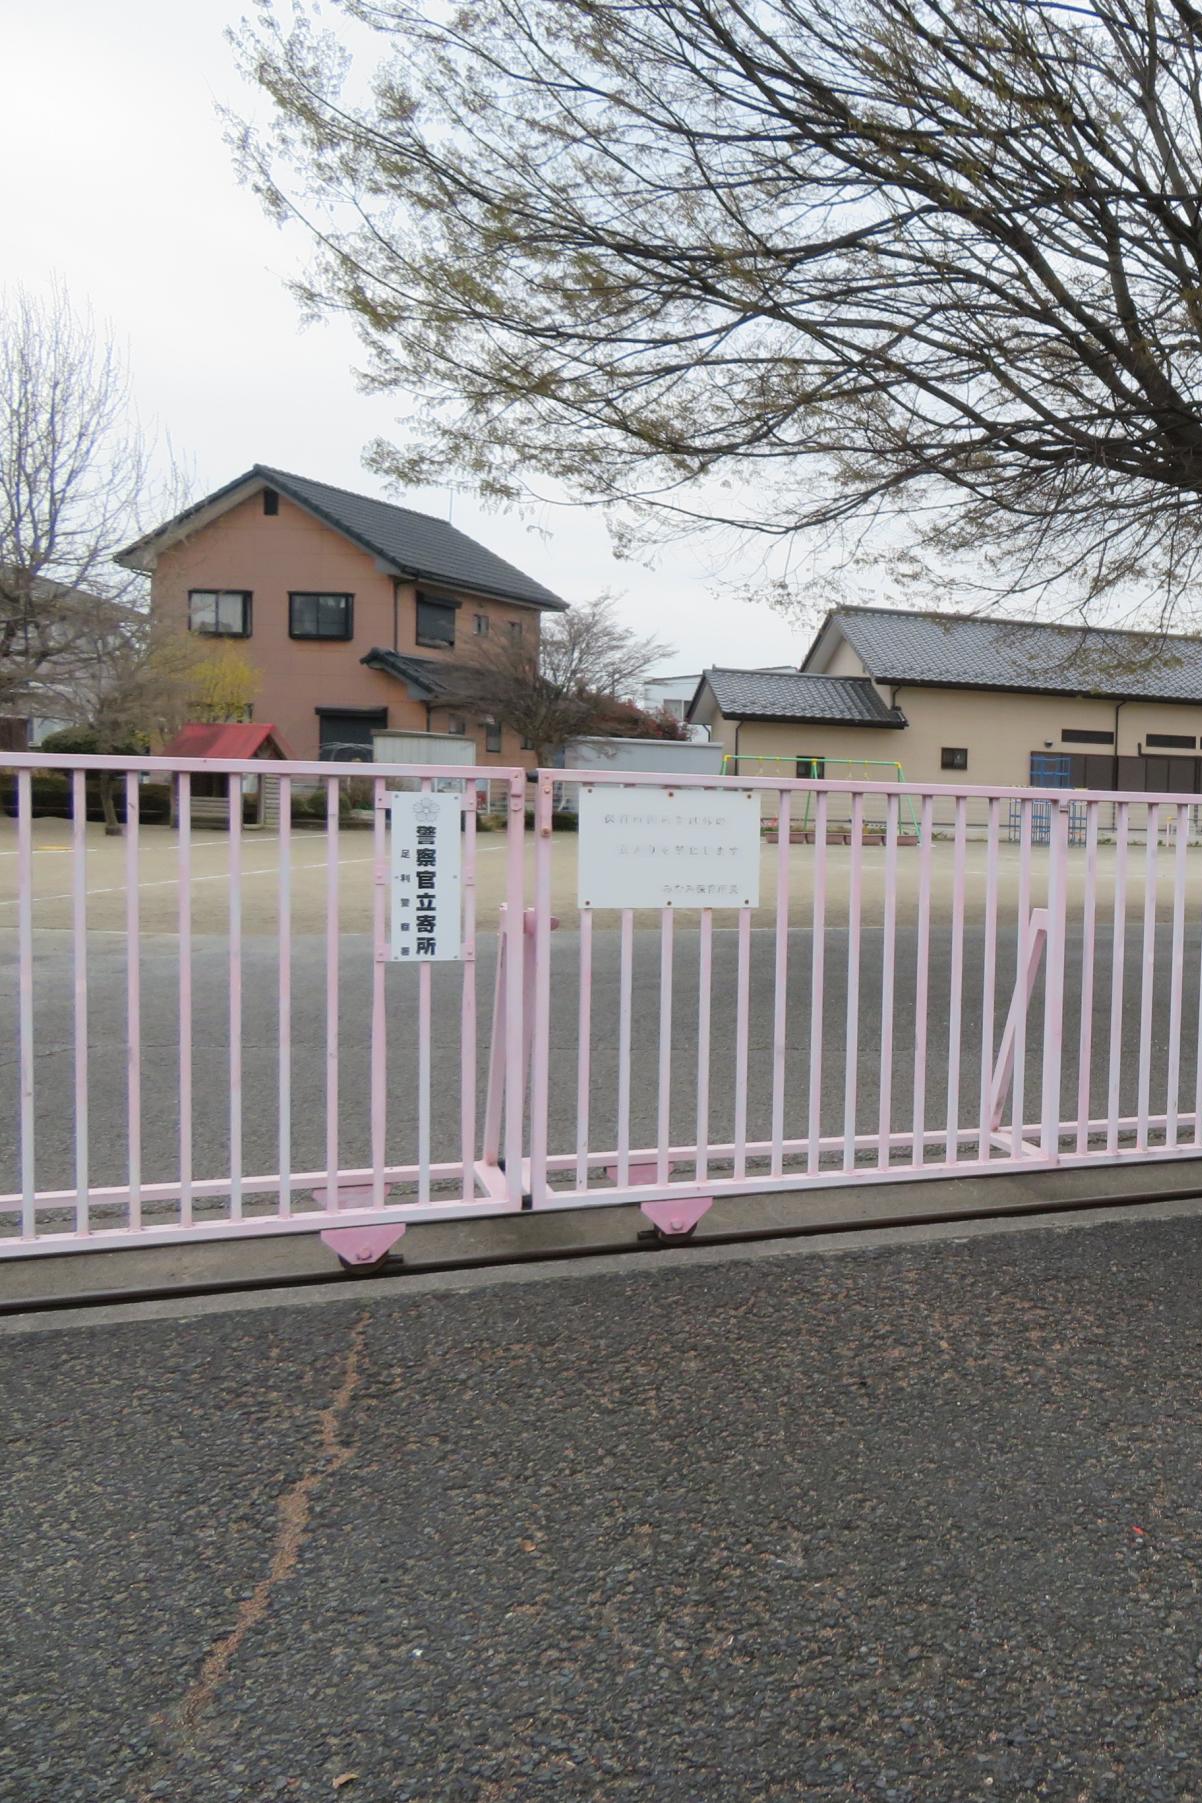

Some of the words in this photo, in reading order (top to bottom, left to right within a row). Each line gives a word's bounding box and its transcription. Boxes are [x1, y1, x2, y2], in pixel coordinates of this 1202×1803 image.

[416, 825, 437, 956] 警察官立寄所
